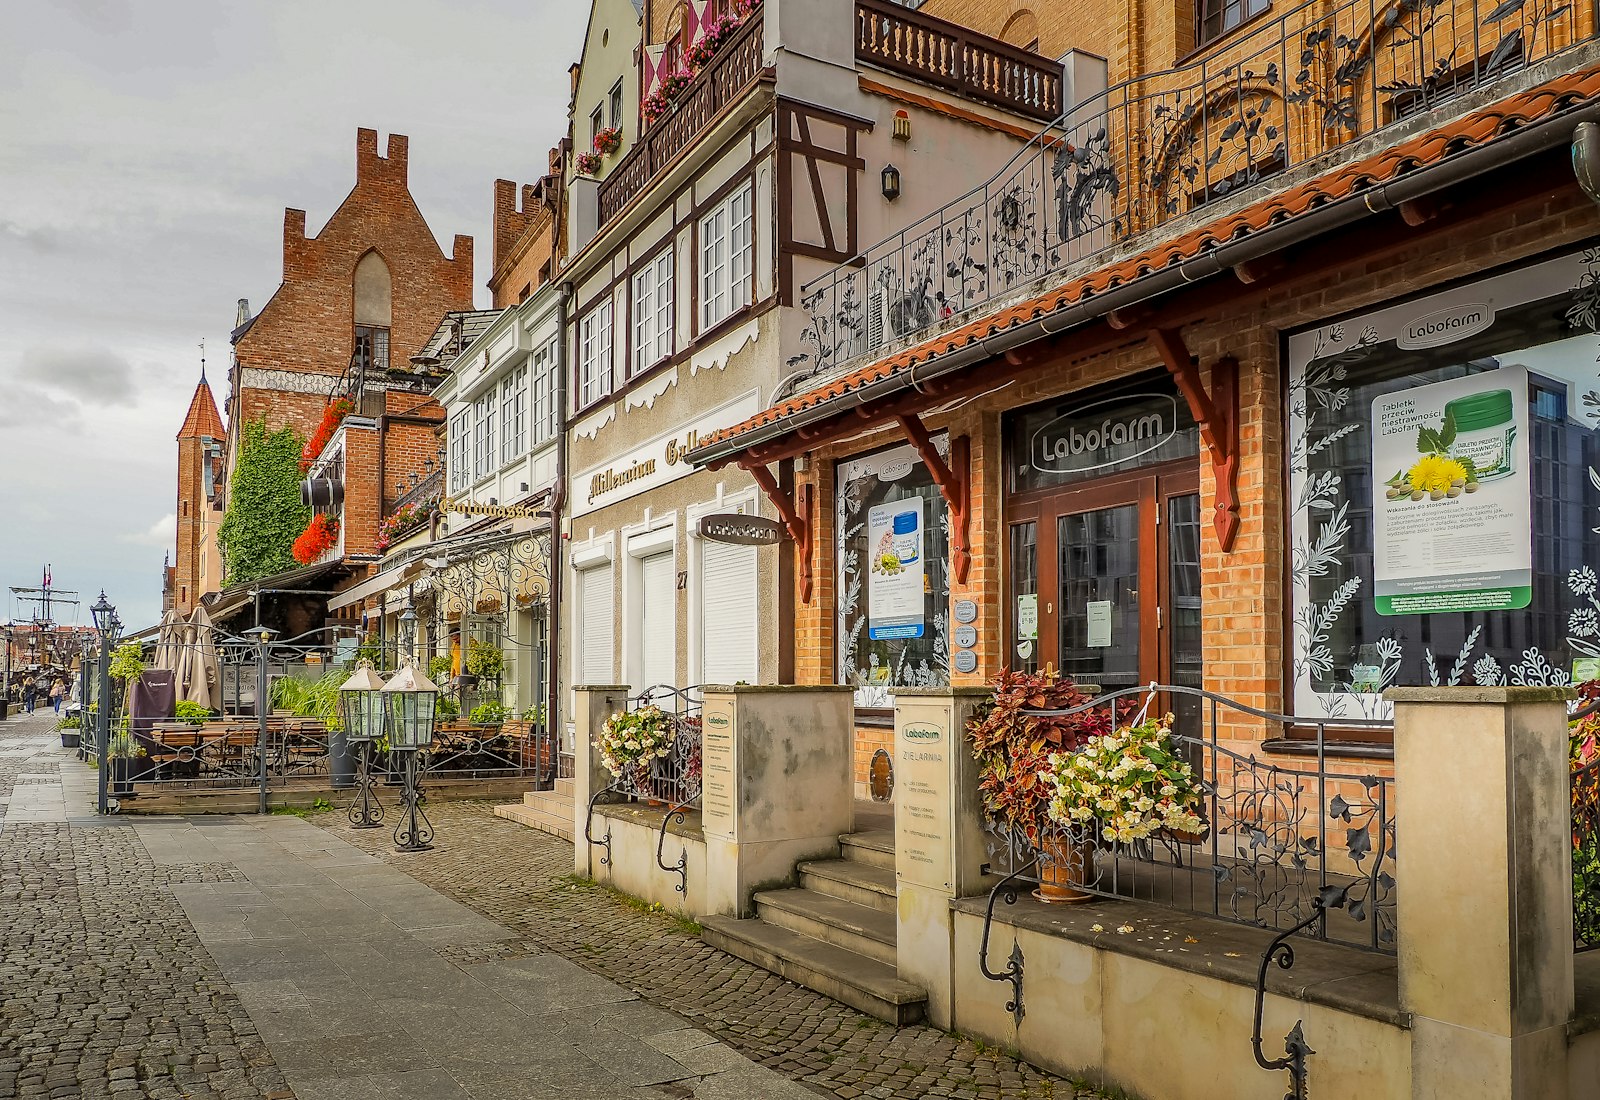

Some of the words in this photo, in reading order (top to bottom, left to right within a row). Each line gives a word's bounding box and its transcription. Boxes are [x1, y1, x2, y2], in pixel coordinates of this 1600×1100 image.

[1409, 312, 1481, 339] Labofarm
[1382, 399, 1416, 411] Tabletki
[1381, 408, 1415, 421] przeciw
[1381, 410, 1441, 428] niestrawności
[1042, 413, 1163, 462] Labofarm
[439, 496, 539, 521] Goldwasser
[1387, 505, 1416, 514] Wskazania
[1426, 500, 1459, 509] stosowania
[707, 520, 778, 539] Labofarm
[677, 570, 688, 590] 27
[905, 728, 940, 739] Labofarm
[903, 751, 942, 762] ZIELARNIA
